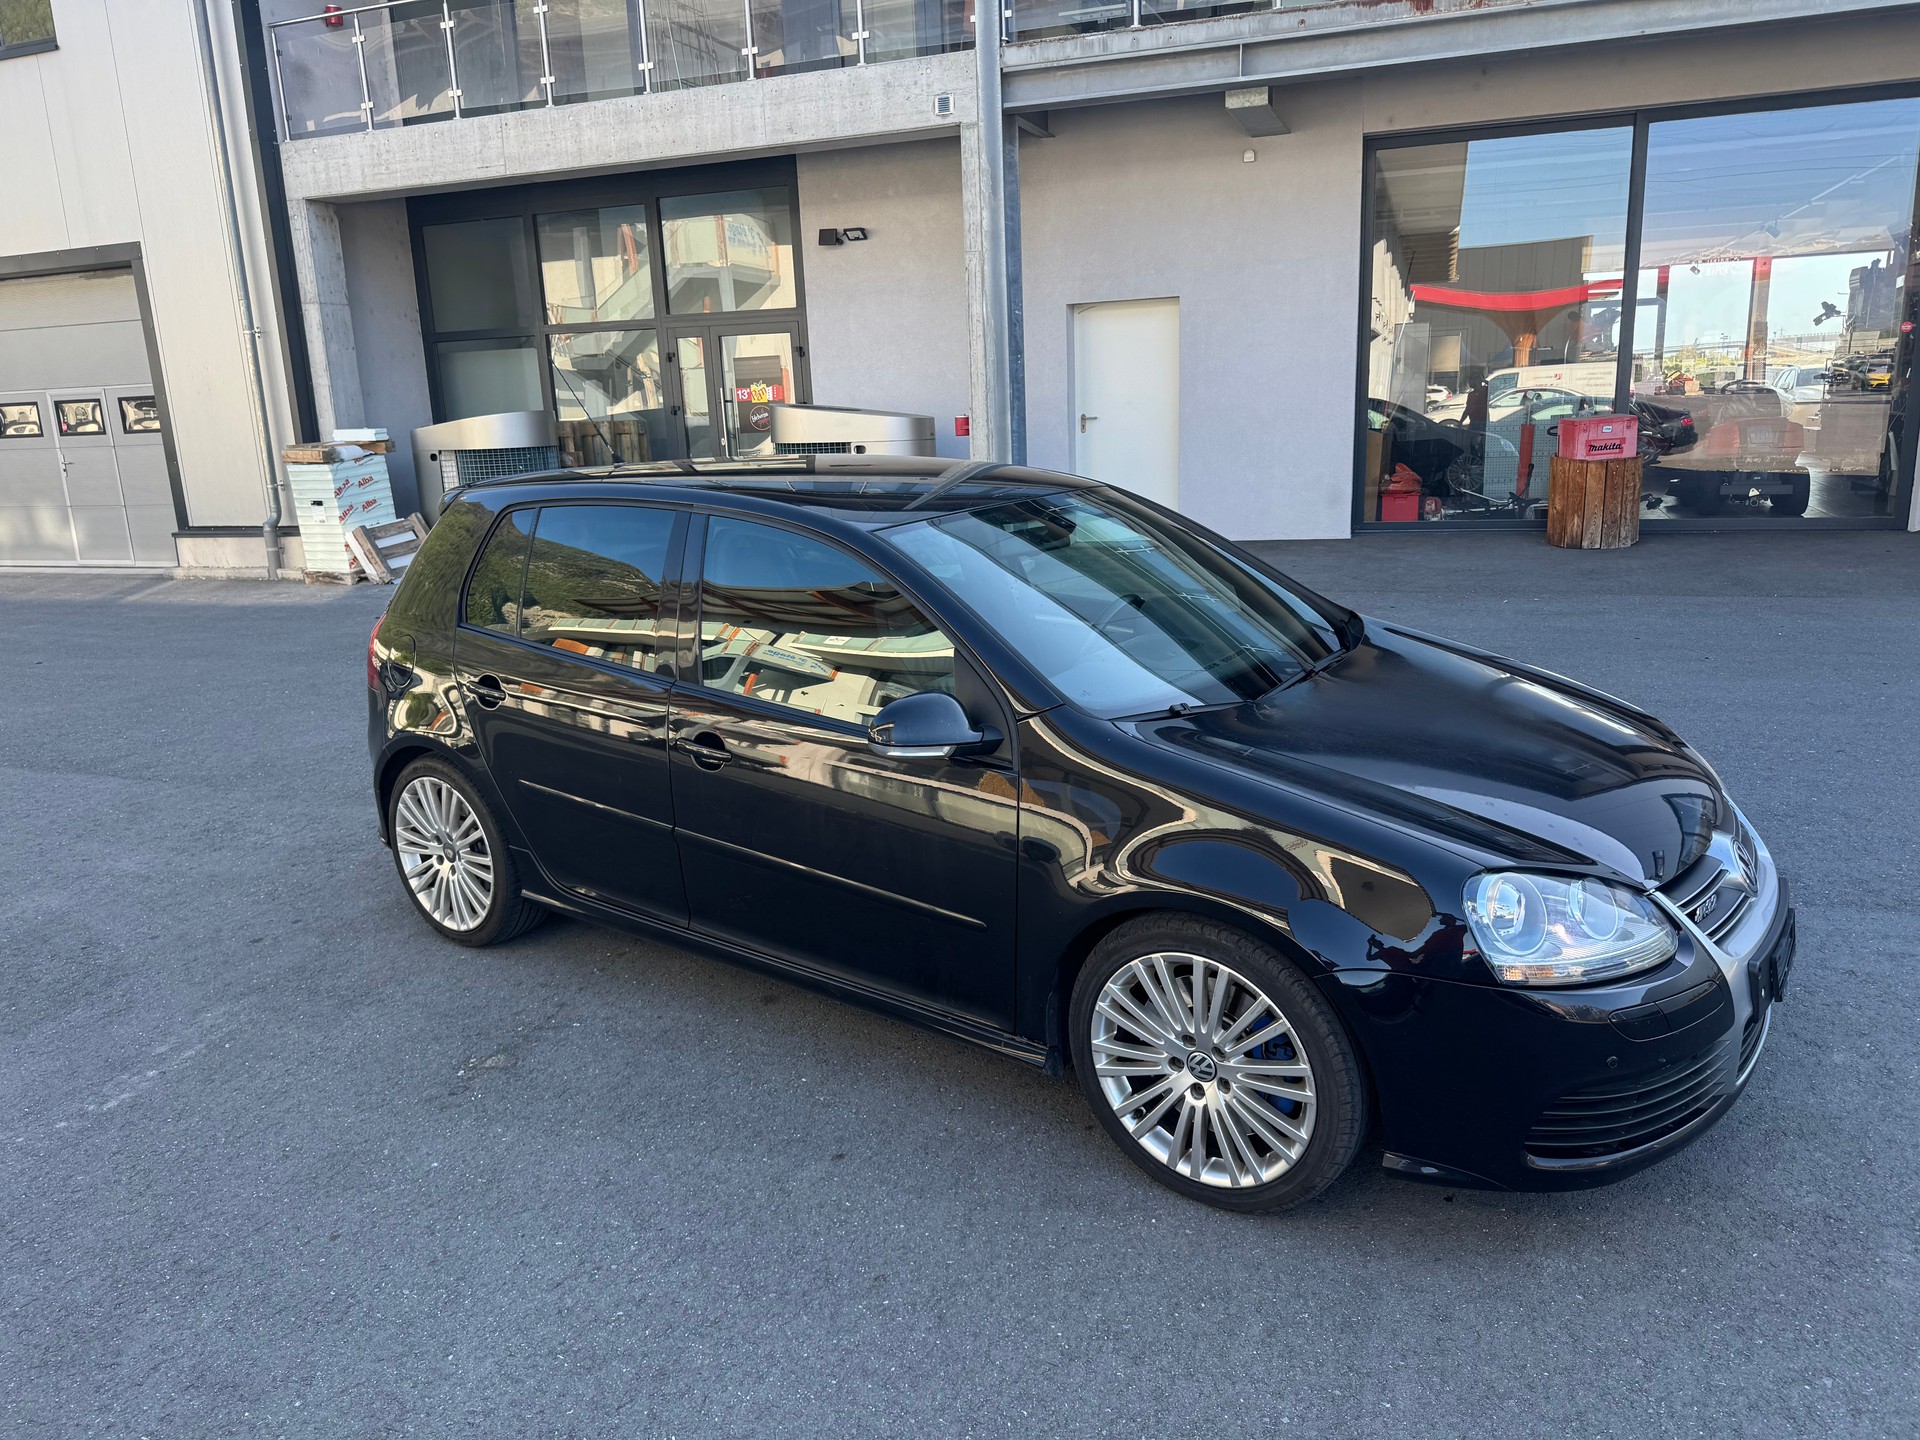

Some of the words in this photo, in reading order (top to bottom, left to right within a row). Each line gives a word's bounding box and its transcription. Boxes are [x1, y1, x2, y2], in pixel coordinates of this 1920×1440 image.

[358, 476, 374, 488] Alba
[362, 499, 377, 511] Alba
[339, 504, 354, 523] Alba
